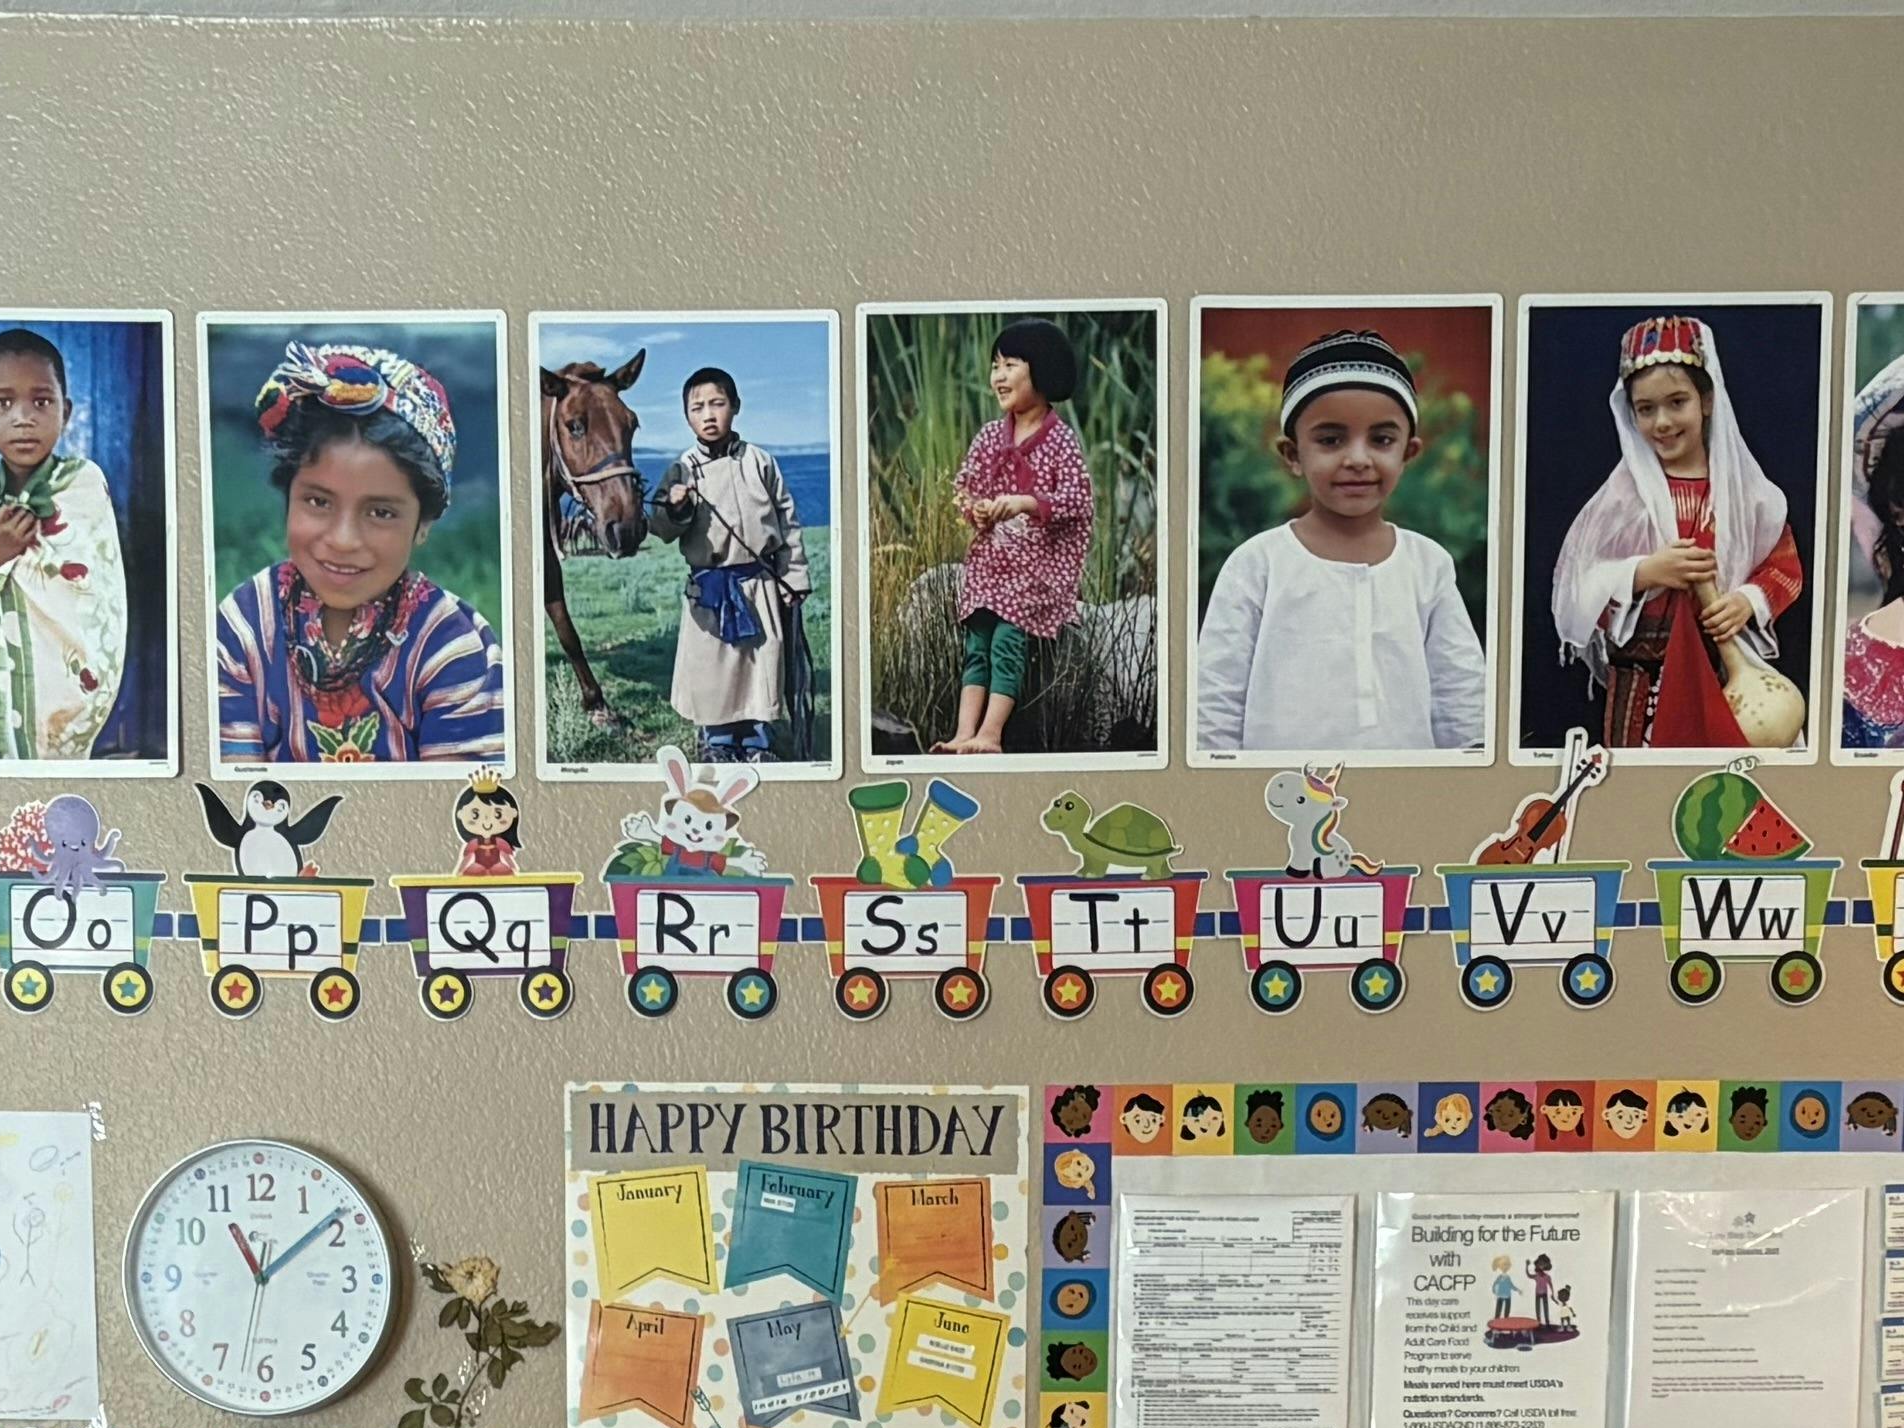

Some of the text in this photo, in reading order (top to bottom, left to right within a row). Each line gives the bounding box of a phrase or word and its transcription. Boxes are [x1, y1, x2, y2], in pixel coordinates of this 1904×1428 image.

[23, 889, 113, 951] Oo
[246, 893, 318, 966] Pp
[440, 893, 531, 966] Qq
[656, 893, 729, 953] Rr
[863, 896, 939, 955] Ss
[1053, 893, 1148, 954] Tt
[1274, 886, 1359, 949] Uu
[1491, 884, 1566, 945] Vv
[1689, 876, 1799, 940] Ww
[590, 1103, 1004, 1157] HAPPY BIRTHDAY
[207, 1184, 232, 1213] 11
[247, 1173, 276, 1202] 12
[298, 1185, 309, 1214] 1
[617, 1183, 682, 1204] January
[761, 1173, 835, 1208] February
[911, 1189, 959, 1207] March
[176, 1217, 206, 1246] 10
[328, 1218, 346, 1248] 2
[1411, 1225, 1581, 1247] Building for the Future
[1429, 1251, 1461, 1267] with
[165, 1264, 182, 1292] 9
[341, 1265, 358, 1293] 3
[1414, 1274, 1477, 1291] CACFP
[180, 1309, 196, 1338] 8
[331, 1310, 349, 1339] 4
[626, 1313, 665, 1336] April
[767, 1318, 801, 1342] May
[934, 1311, 970, 1335] June
[213, 1343, 230, 1371] 7
[257, 1354, 274, 1383] 6
[300, 1343, 316, 1371] 5
